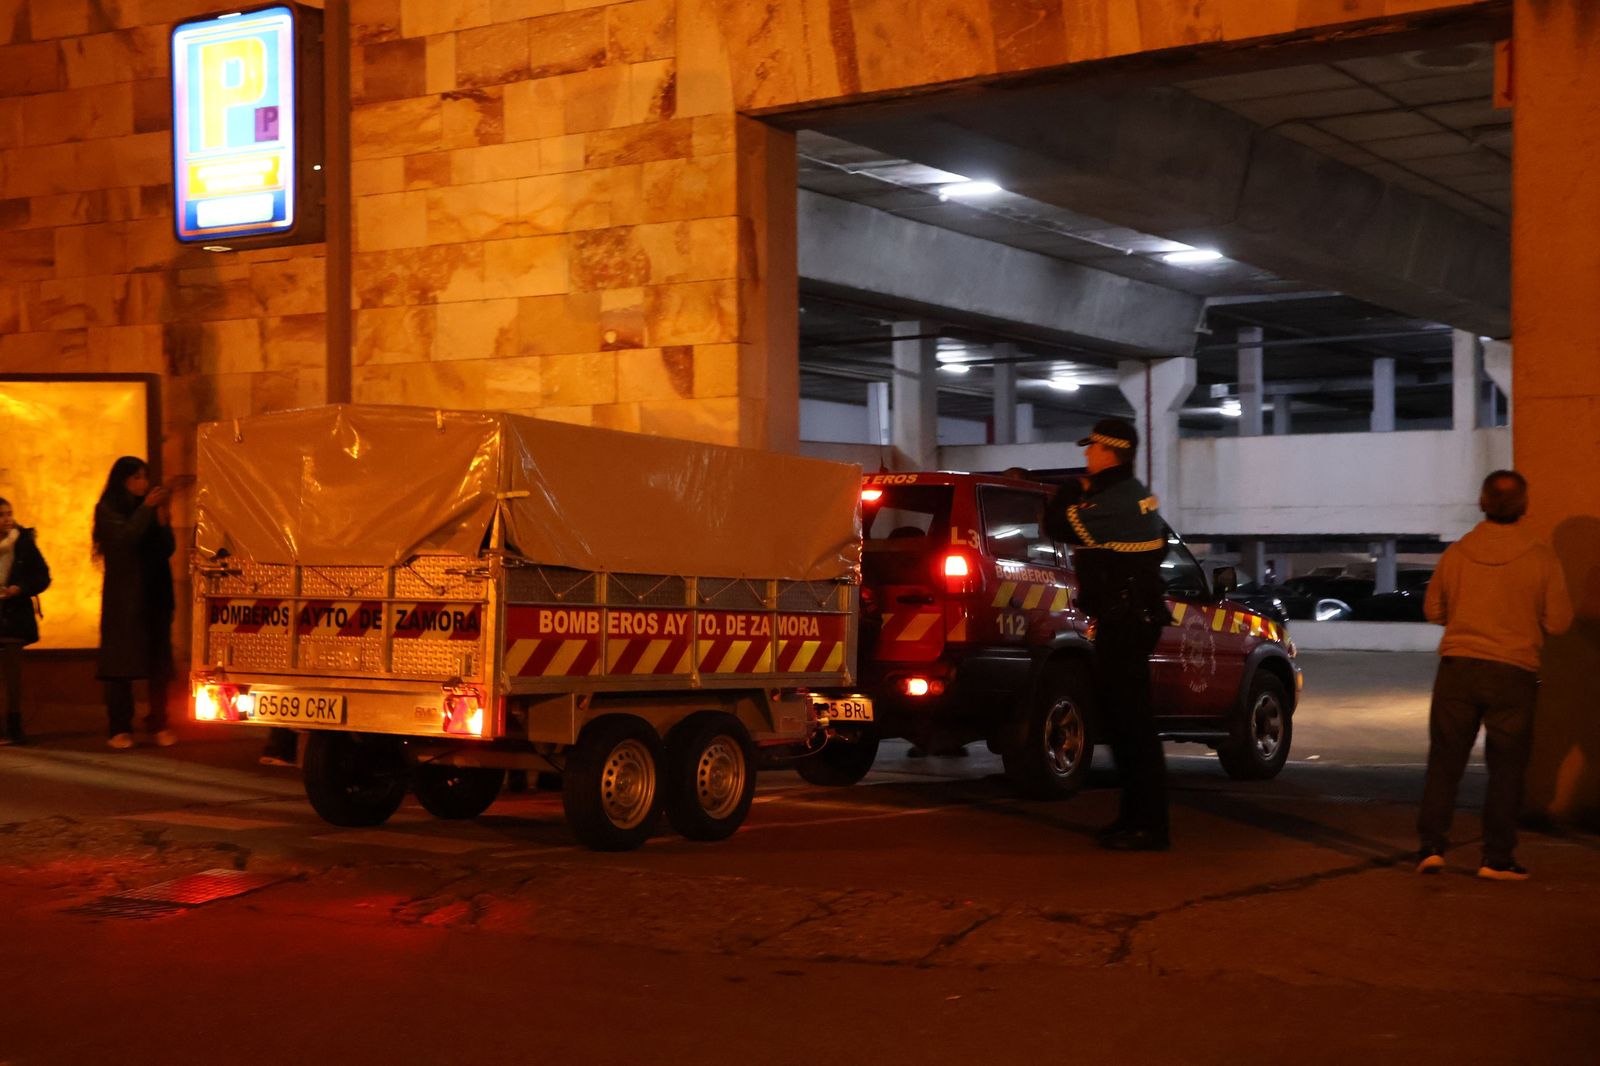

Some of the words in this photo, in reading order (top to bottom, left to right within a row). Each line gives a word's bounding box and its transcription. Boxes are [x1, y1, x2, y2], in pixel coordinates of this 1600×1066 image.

[200, 36, 267, 152] P
[263, 108, 278, 132] P
[995, 564, 1056, 584] BOMBEROS
[210, 605, 289, 627] BOMBEROS
[301, 607, 352, 628] AYTO.
[360, 608, 382, 630] DE
[395, 609, 480, 632] ZAMORA
[726, 614, 746, 636] DE
[996, 613, 1025, 636] 112
[259, 695, 300, 717] 6569
[305, 697, 337, 719] CRK
[844, 702, 870, 719] BRL
